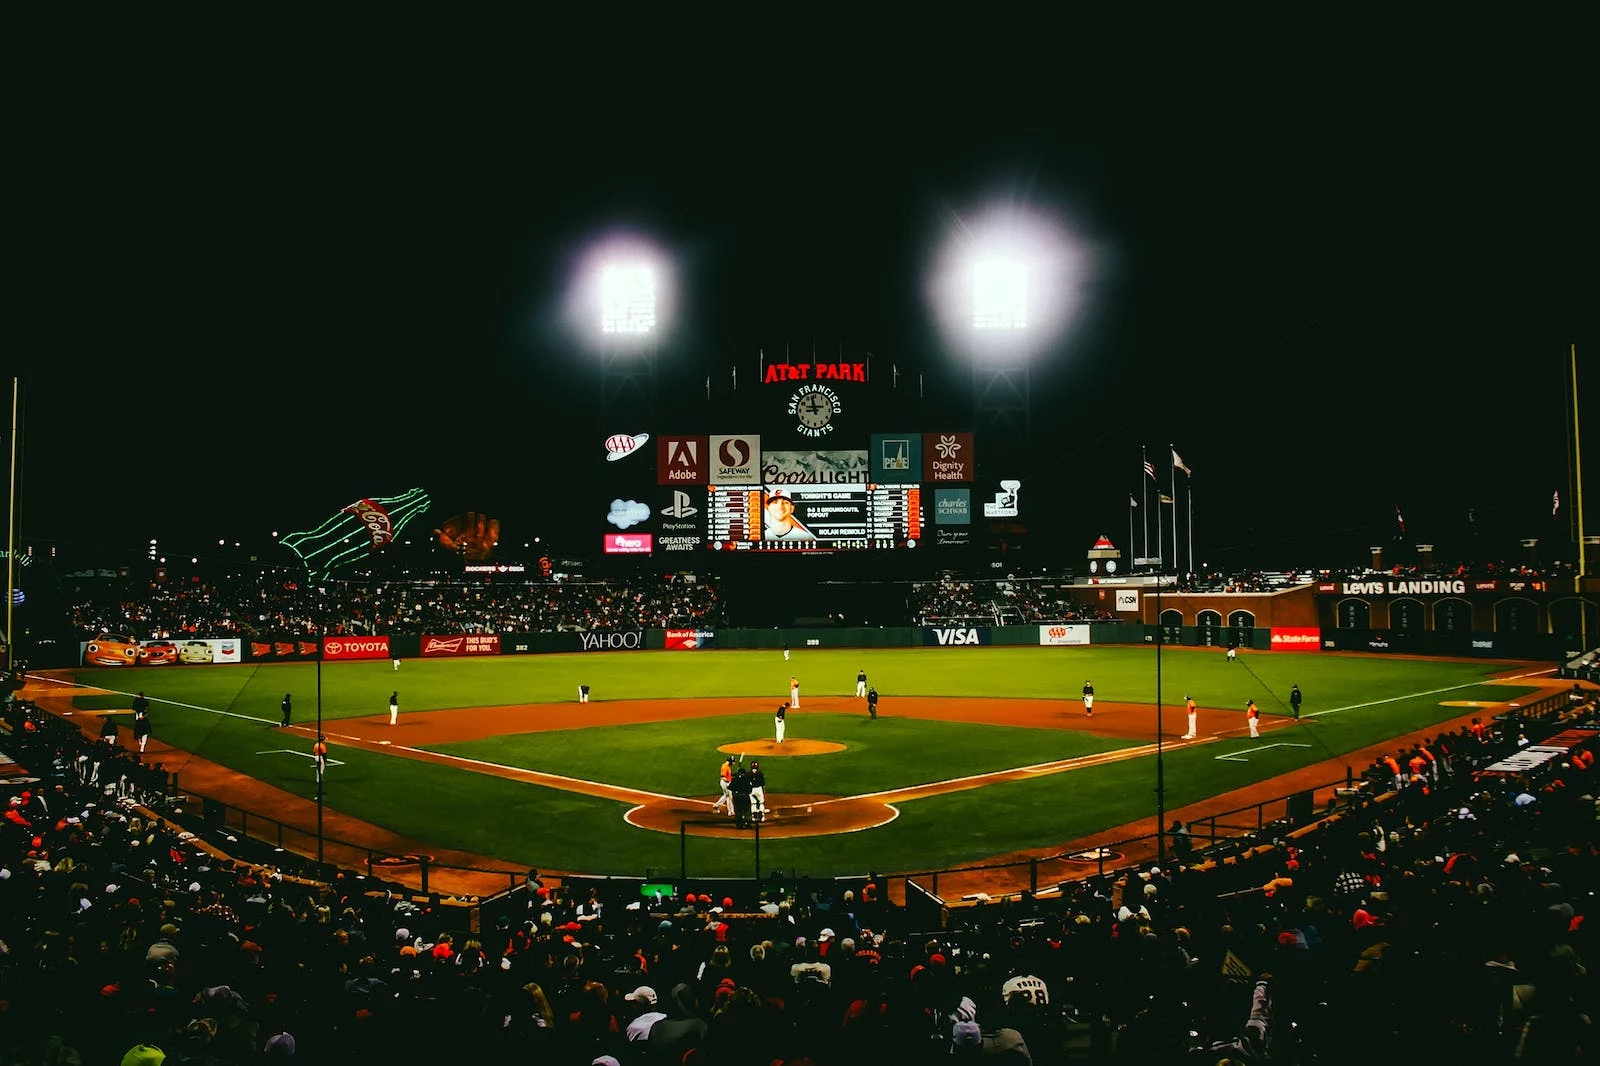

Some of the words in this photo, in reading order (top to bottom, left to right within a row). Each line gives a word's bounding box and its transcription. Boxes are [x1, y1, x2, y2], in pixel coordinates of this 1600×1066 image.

[764, 364, 811, 383] AT&T
[815, 363, 865, 383] PARK
[788, 394, 800, 415] SAN
[798, 384, 842, 414] FRANCISCO
[797, 423, 834, 437] GIANTS
[718, 467, 750, 475] SAFEWAY
[932, 461, 964, 471] Dignity
[668, 469, 697, 480] Adobe
[762, 465, 818, 484] Coors
[820, 470, 869, 484] LIGHT
[934, 471, 963, 480] Health
[938, 498, 967, 508] charles
[938, 507, 968, 515] SCHWAB
[361, 510, 392, 546] Cola
[662, 523, 696, 531] PlayStation
[658, 536, 701, 545] GREATNESS
[665, 543, 694, 551] AWAITS
[1388, 580, 1466, 594] LANDING
[480, 636, 498, 644] BUD'S
[579, 631, 643, 650] YAHOO!
[932, 628, 980, 645] VISA
[1283, 634, 1302, 643] State
[1302, 635, 1320, 643] Farm
[343, 641, 389, 653] TOYOTA
[466, 644, 478, 652] FOR
[479, 644, 492, 652] YOU.
